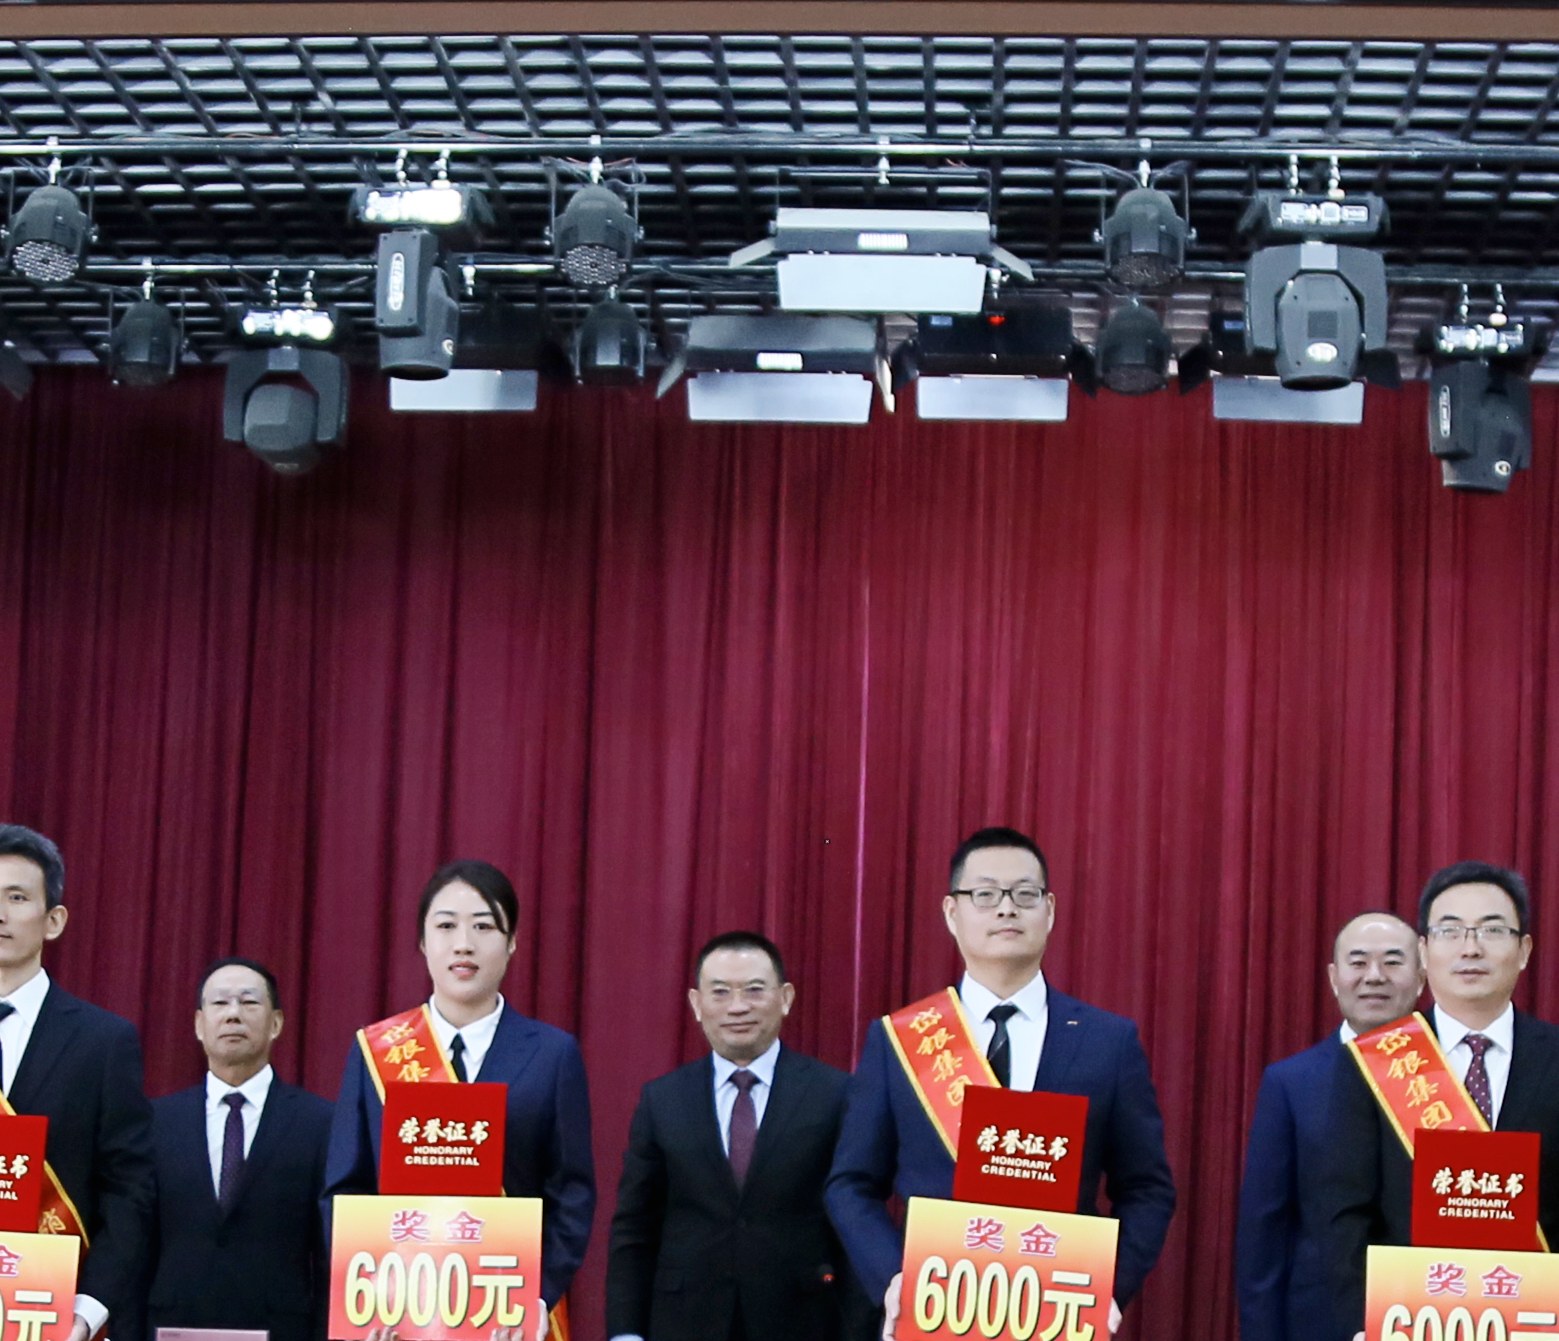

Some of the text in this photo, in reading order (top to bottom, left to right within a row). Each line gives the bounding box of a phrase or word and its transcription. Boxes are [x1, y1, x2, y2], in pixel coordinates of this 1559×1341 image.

[398, 1117, 490, 1145] 荣誉证书
[976, 1125, 1069, 1161] 荣誉证书
[405, 1156, 480, 1166] CREDENTIAL
[413, 1146, 474, 1155] HONORARY
[991, 1155, 1052, 1170] HONORARY
[981, 1164, 1057, 1182] CREDENTIAL
[1432, 1167, 1524, 1198] 荣誉证书
[1438, 1206, 1515, 1220] CREDENTIAL
[1448, 1197, 1509, 1208] HONORARY
[390, 1209, 485, 1243] 奖金
[964, 1216, 1060, 1258] 奖金
[344, 1251, 525, 1328] 6000元
[1426, 1263, 1523, 1299] 奖金
